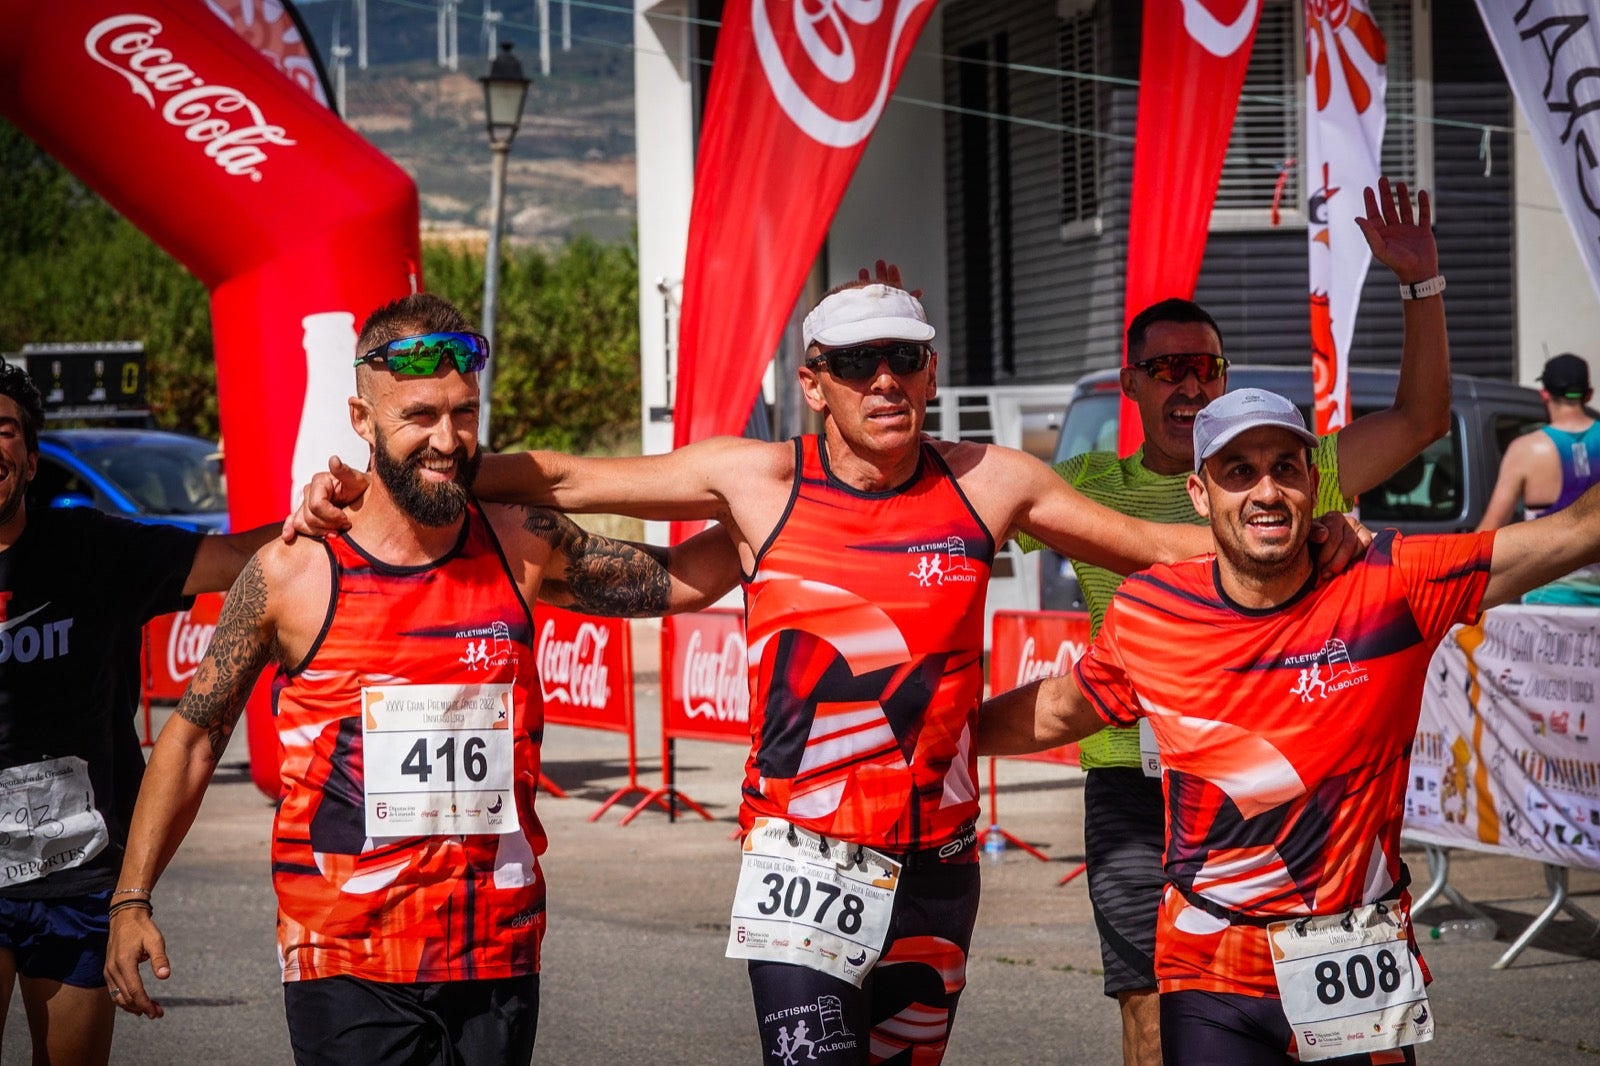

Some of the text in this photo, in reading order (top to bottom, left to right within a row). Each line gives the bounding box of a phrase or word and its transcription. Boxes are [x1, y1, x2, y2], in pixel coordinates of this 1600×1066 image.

[84, 13, 297, 178] Coca-Cola
[907, 542, 947, 553] ATLETISMO
[455, 627, 492, 638] ATLETISMO
[1327, 674, 1369, 693] ALBOLOTE
[401, 737, 488, 782] 416
[5, 846, 86, 880] DEPORTES
[757, 872, 865, 935] 3078
[1315, 949, 1401, 1005] 808
[764, 1003, 817, 1024] ATLETISMO
[818, 1040, 857, 1053] ALBOLOTE
